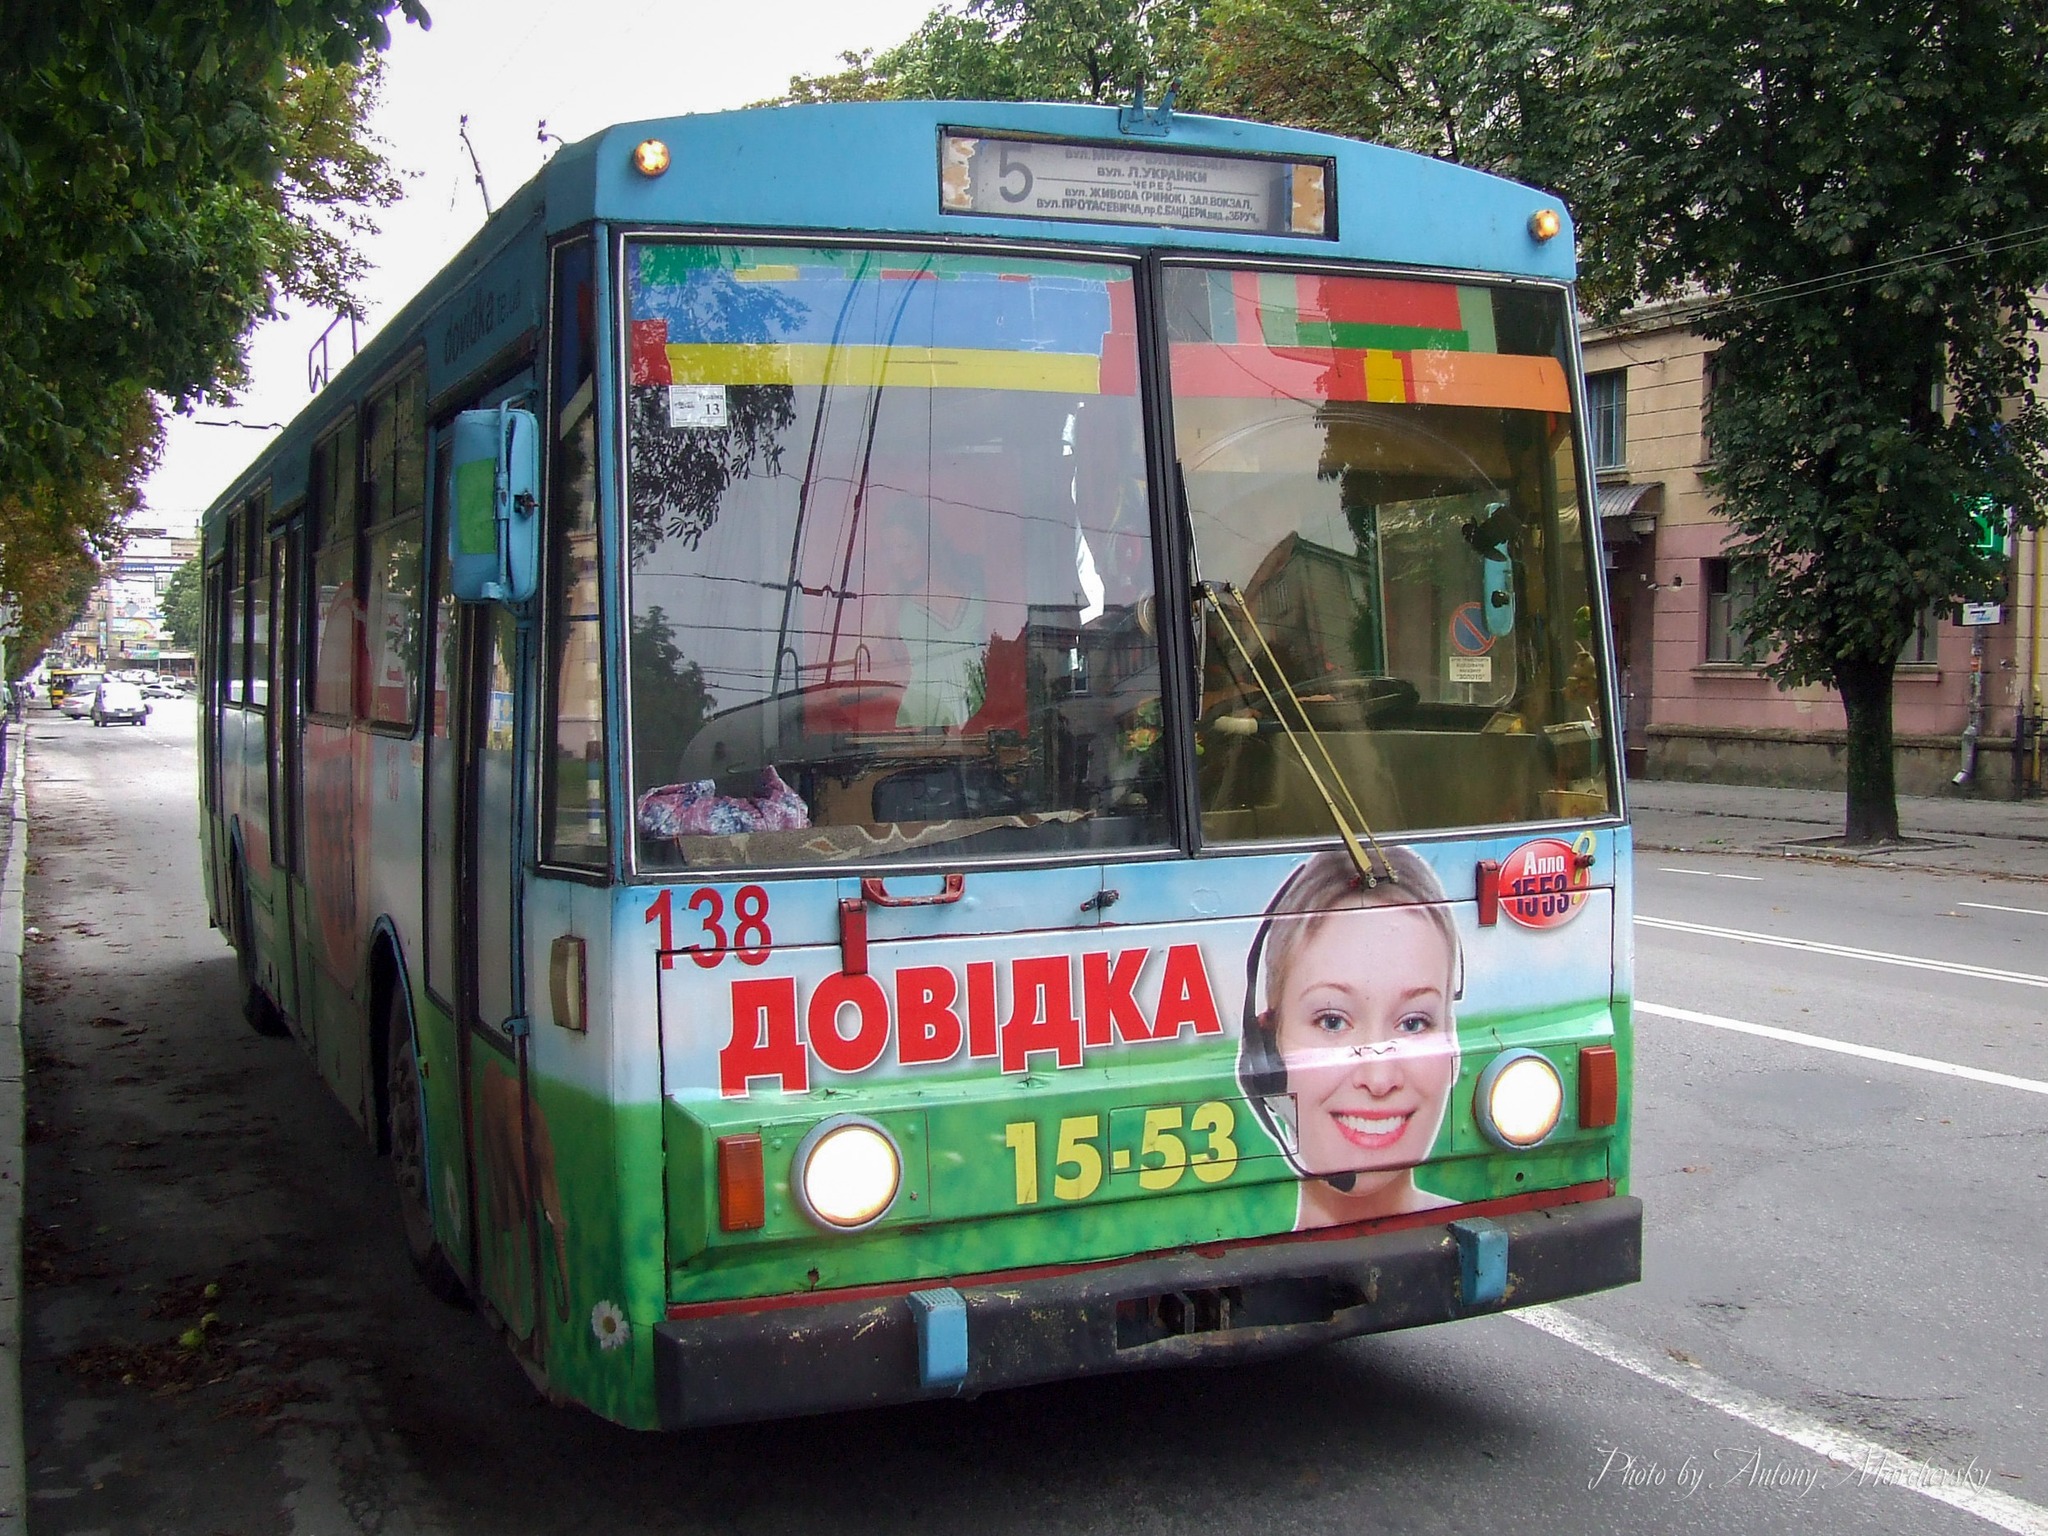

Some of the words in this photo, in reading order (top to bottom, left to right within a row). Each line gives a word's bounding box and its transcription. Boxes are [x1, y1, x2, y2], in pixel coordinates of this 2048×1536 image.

[999, 143, 1033, 203] 5
[1133, 180, 1173, 191] ЧЕРЕЗ
[705, 403, 720, 416] 13
[644, 884, 773, 970] 138
[719, 943, 1223, 1098] ДОВІДКА
[1005, 1101, 1239, 1205] 15-53
